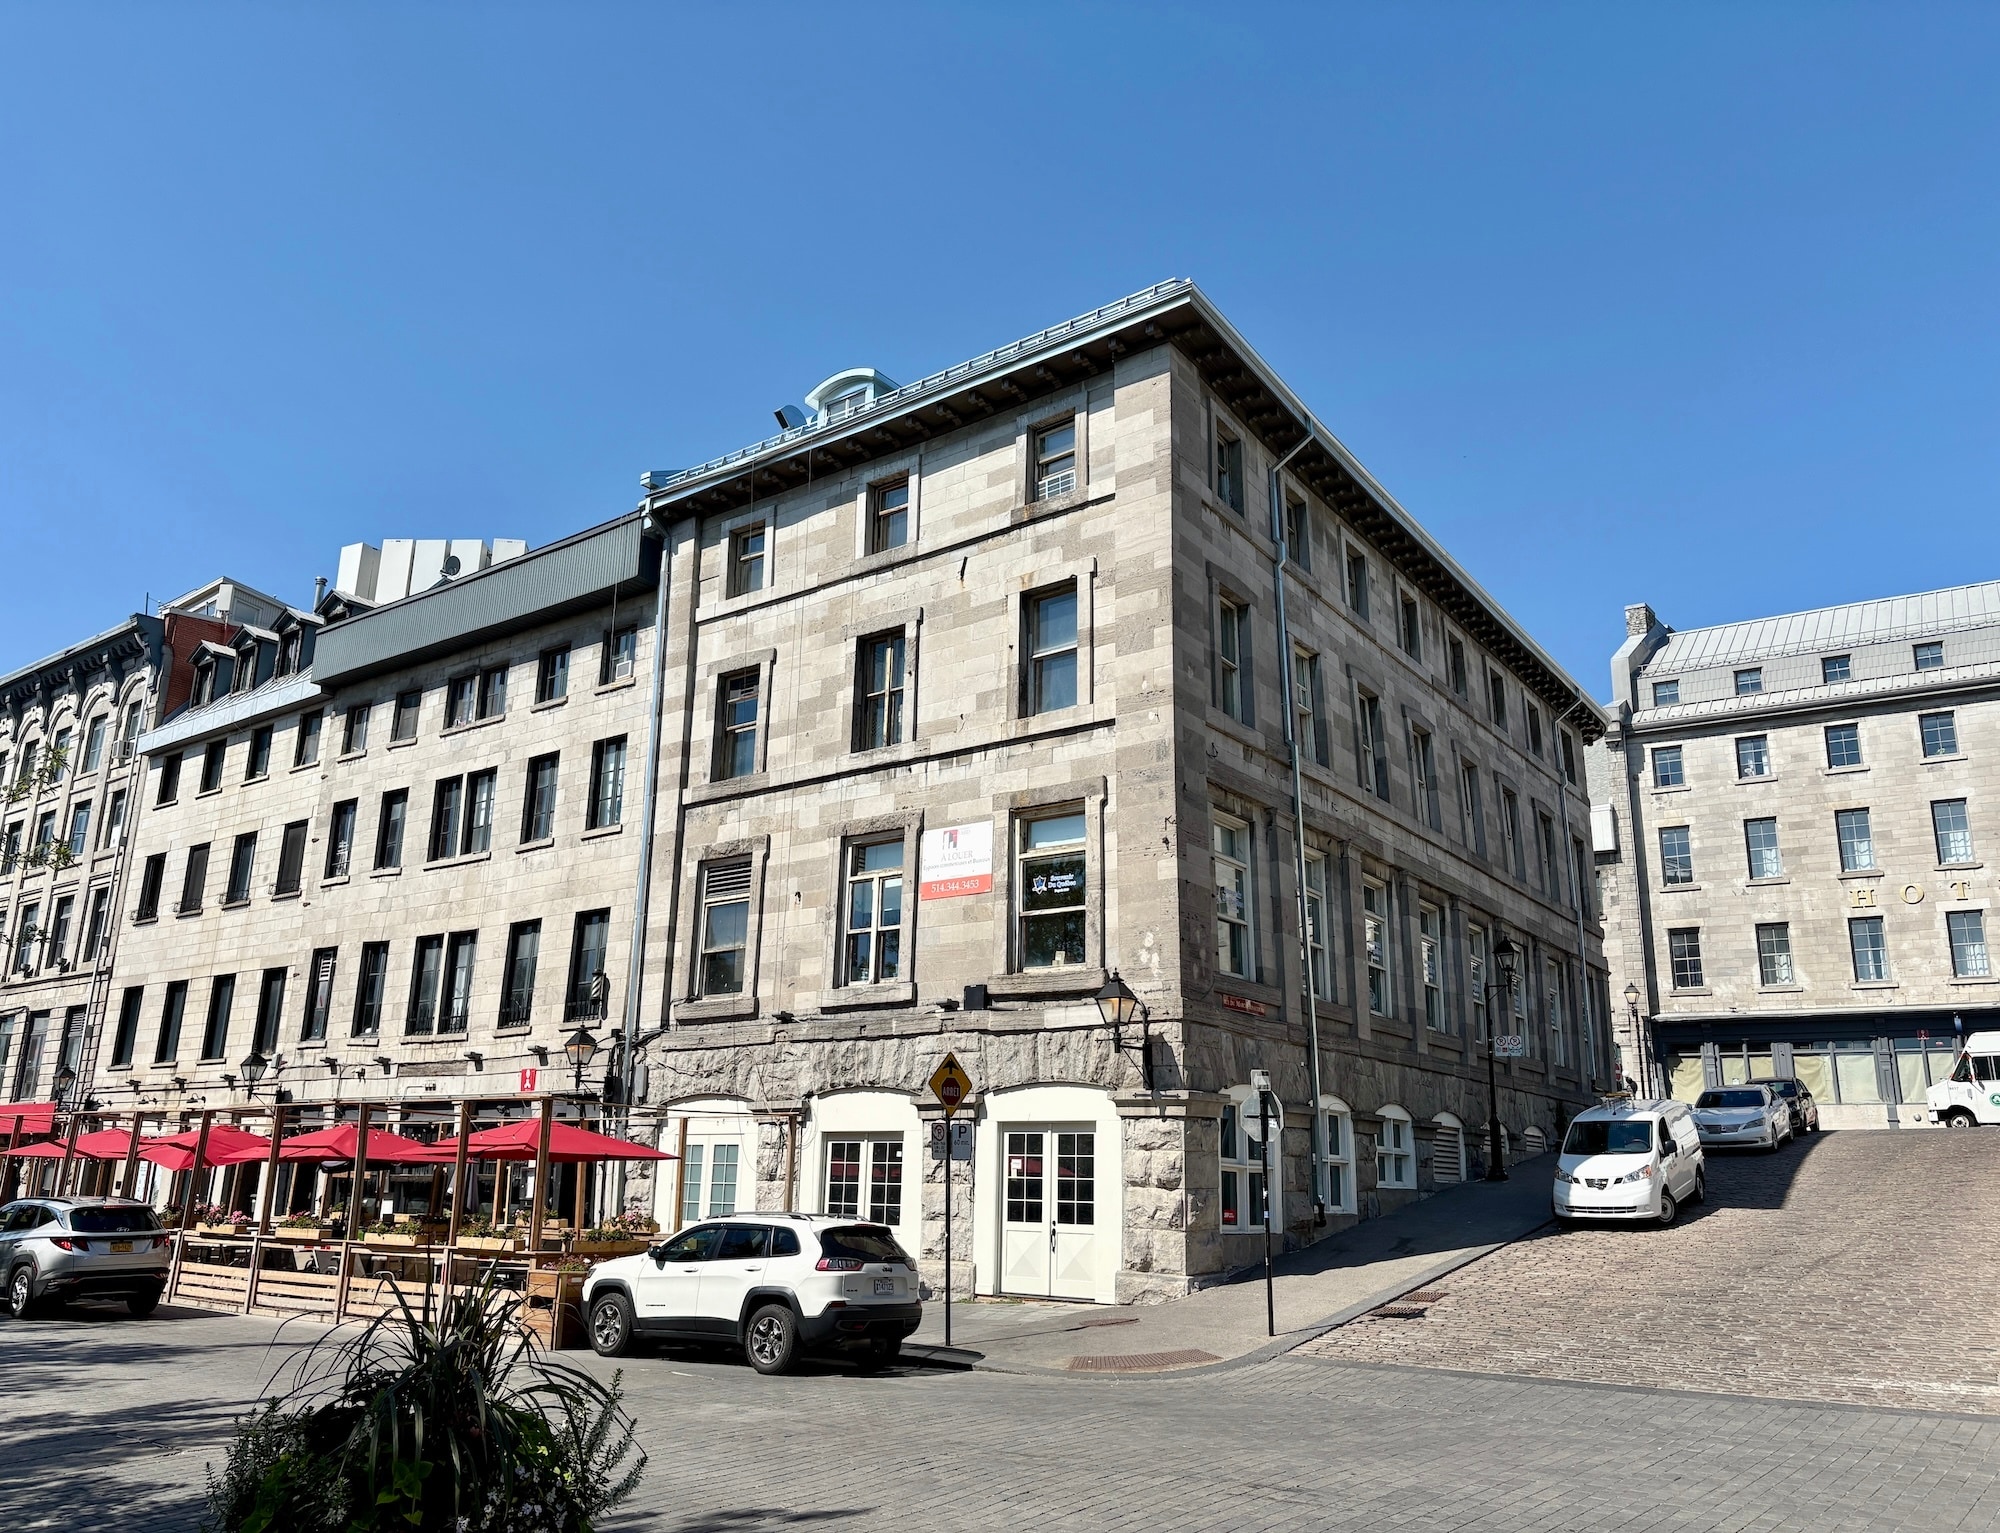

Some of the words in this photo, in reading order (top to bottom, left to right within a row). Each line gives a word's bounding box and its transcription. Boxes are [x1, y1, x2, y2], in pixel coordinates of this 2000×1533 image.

[948, 850, 973, 861] LOUER
[1050, 873, 1074, 881] Souvenir
[931, 879, 979, 893] 514.344.3453
[943, 1086, 960, 1097] ARRÊT
